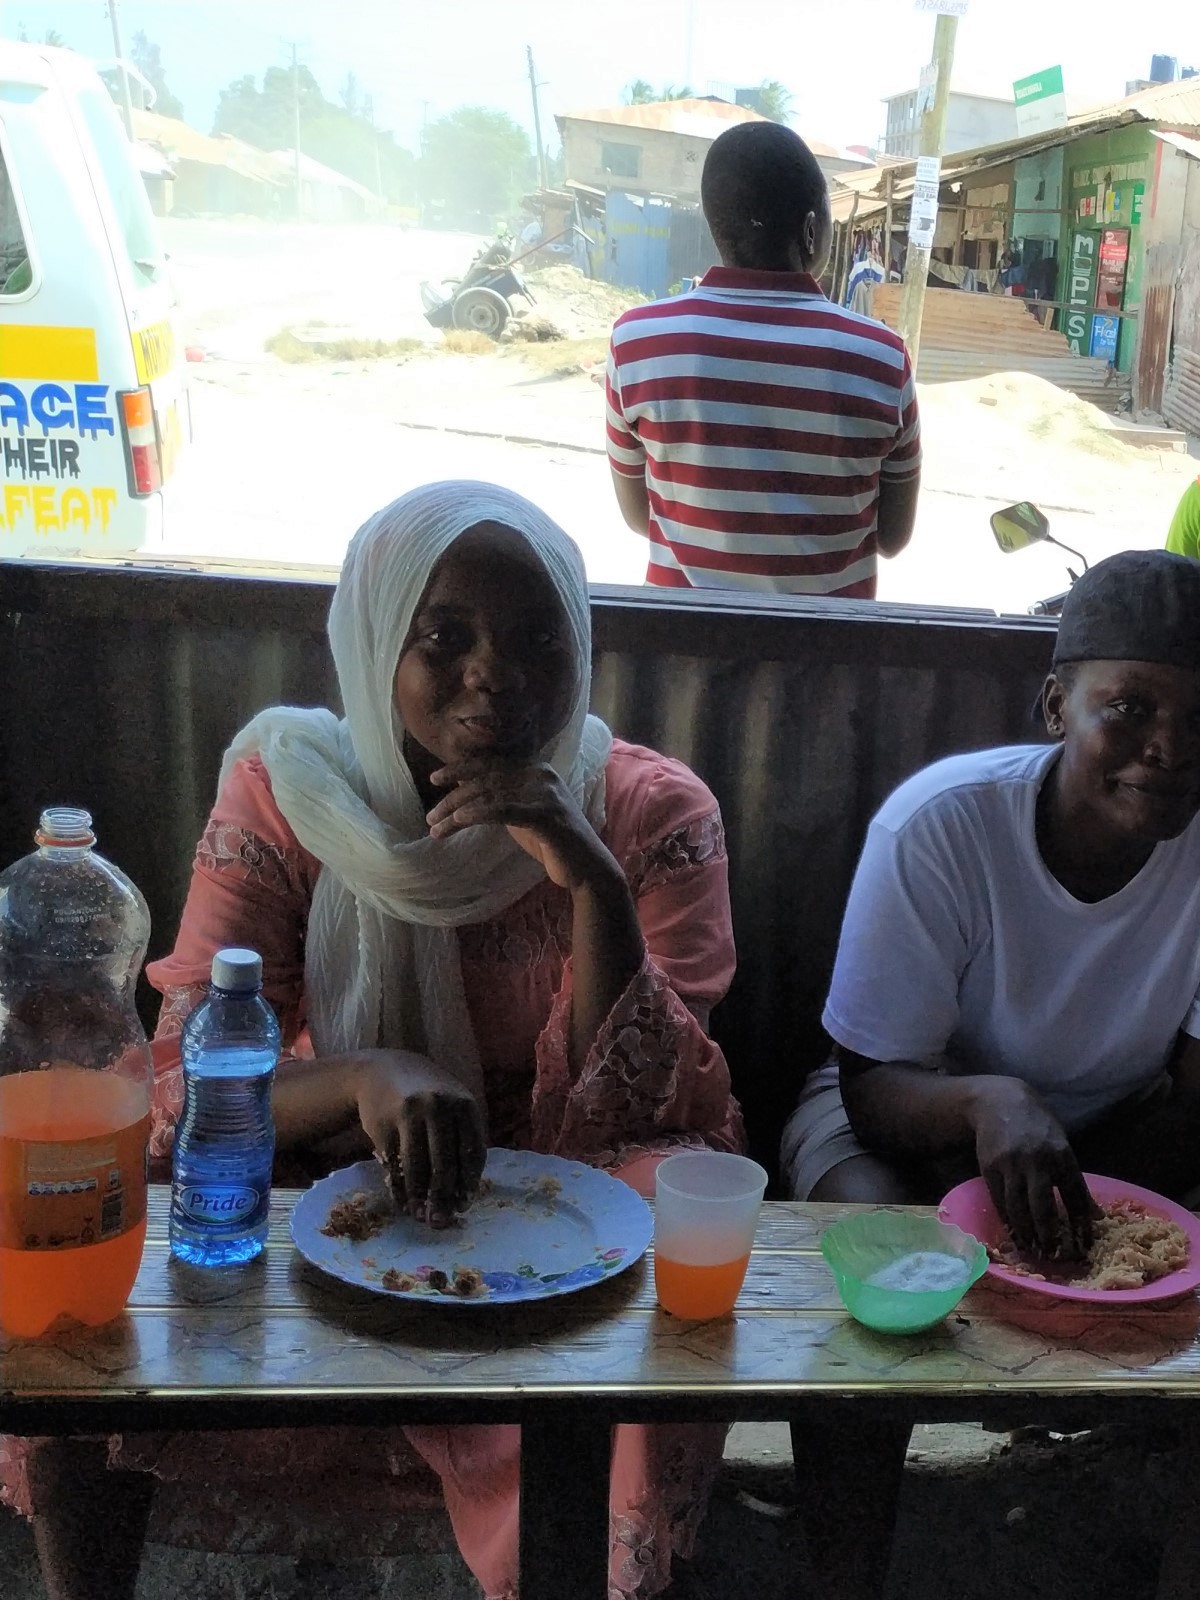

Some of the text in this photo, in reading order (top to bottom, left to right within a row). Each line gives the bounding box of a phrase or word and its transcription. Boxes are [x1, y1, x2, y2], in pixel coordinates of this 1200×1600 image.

[0, 437, 81, 480] HEIR
[0, 484, 117, 535] FEAT
[190, 1192, 247, 1212] Pride
